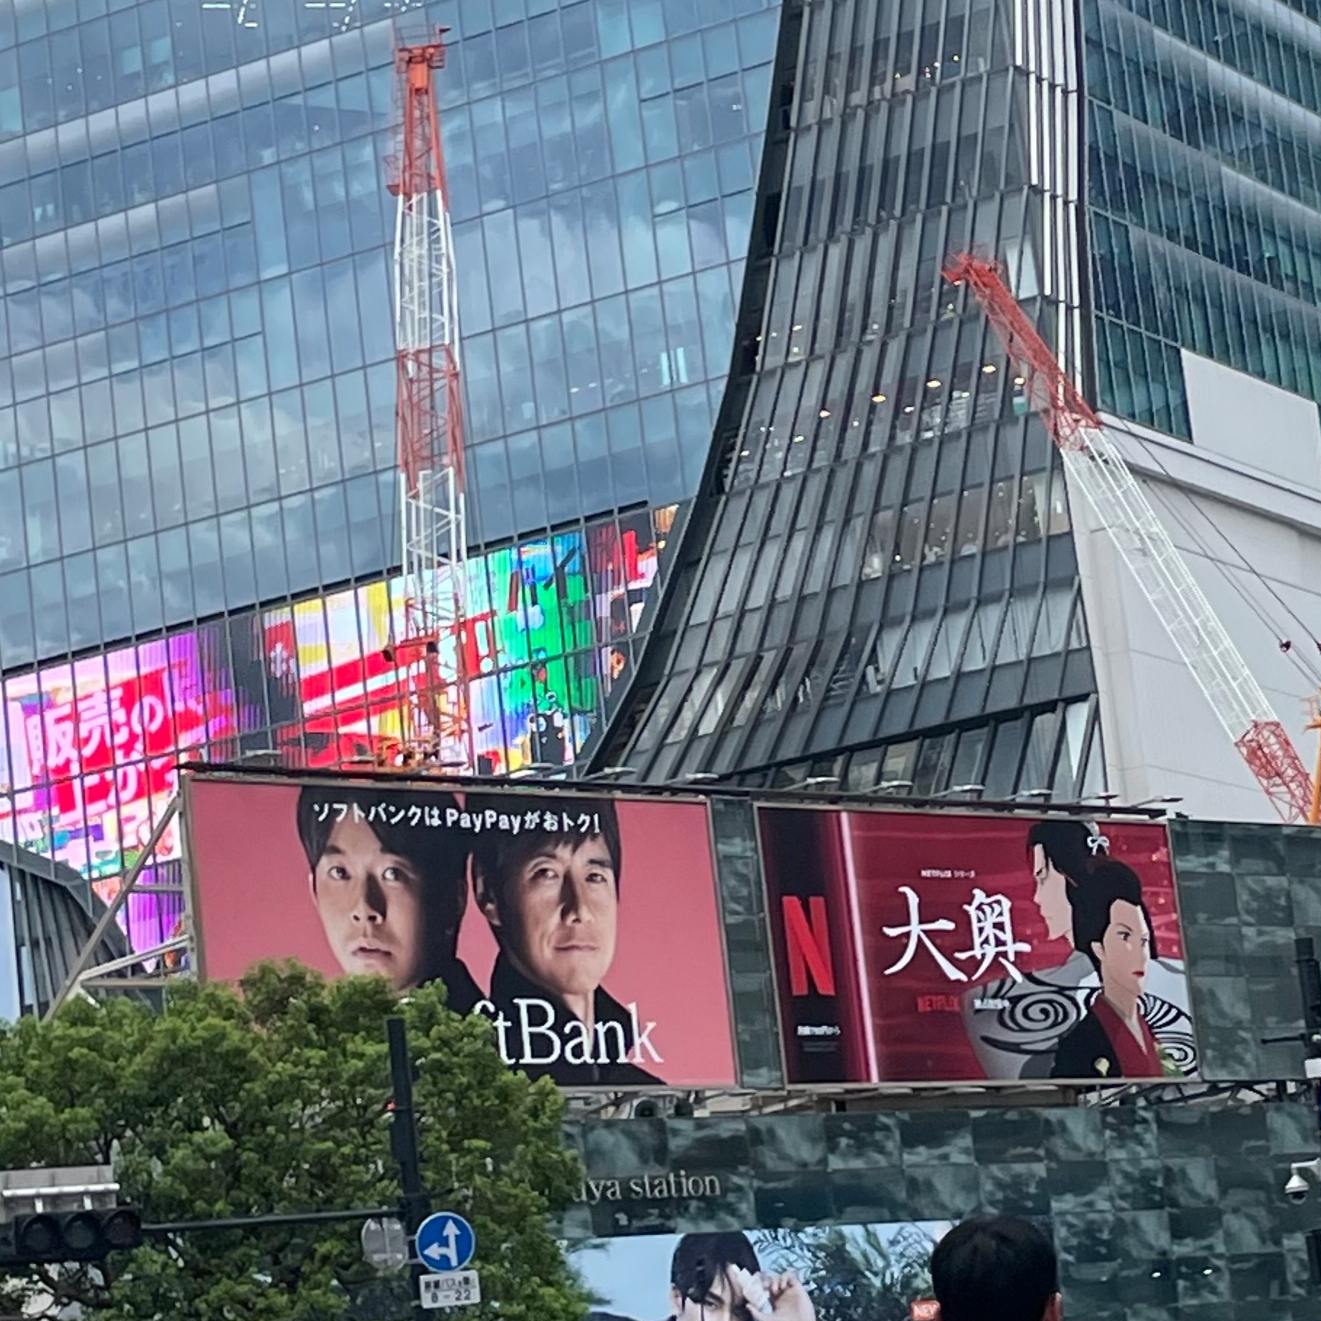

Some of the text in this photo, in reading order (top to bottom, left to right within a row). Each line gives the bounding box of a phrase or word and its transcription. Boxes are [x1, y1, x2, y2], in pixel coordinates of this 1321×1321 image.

[782, 896, 836, 996] N
[882, 885, 1031, 983] 大奥
[629, 1169, 721, 1199] station
